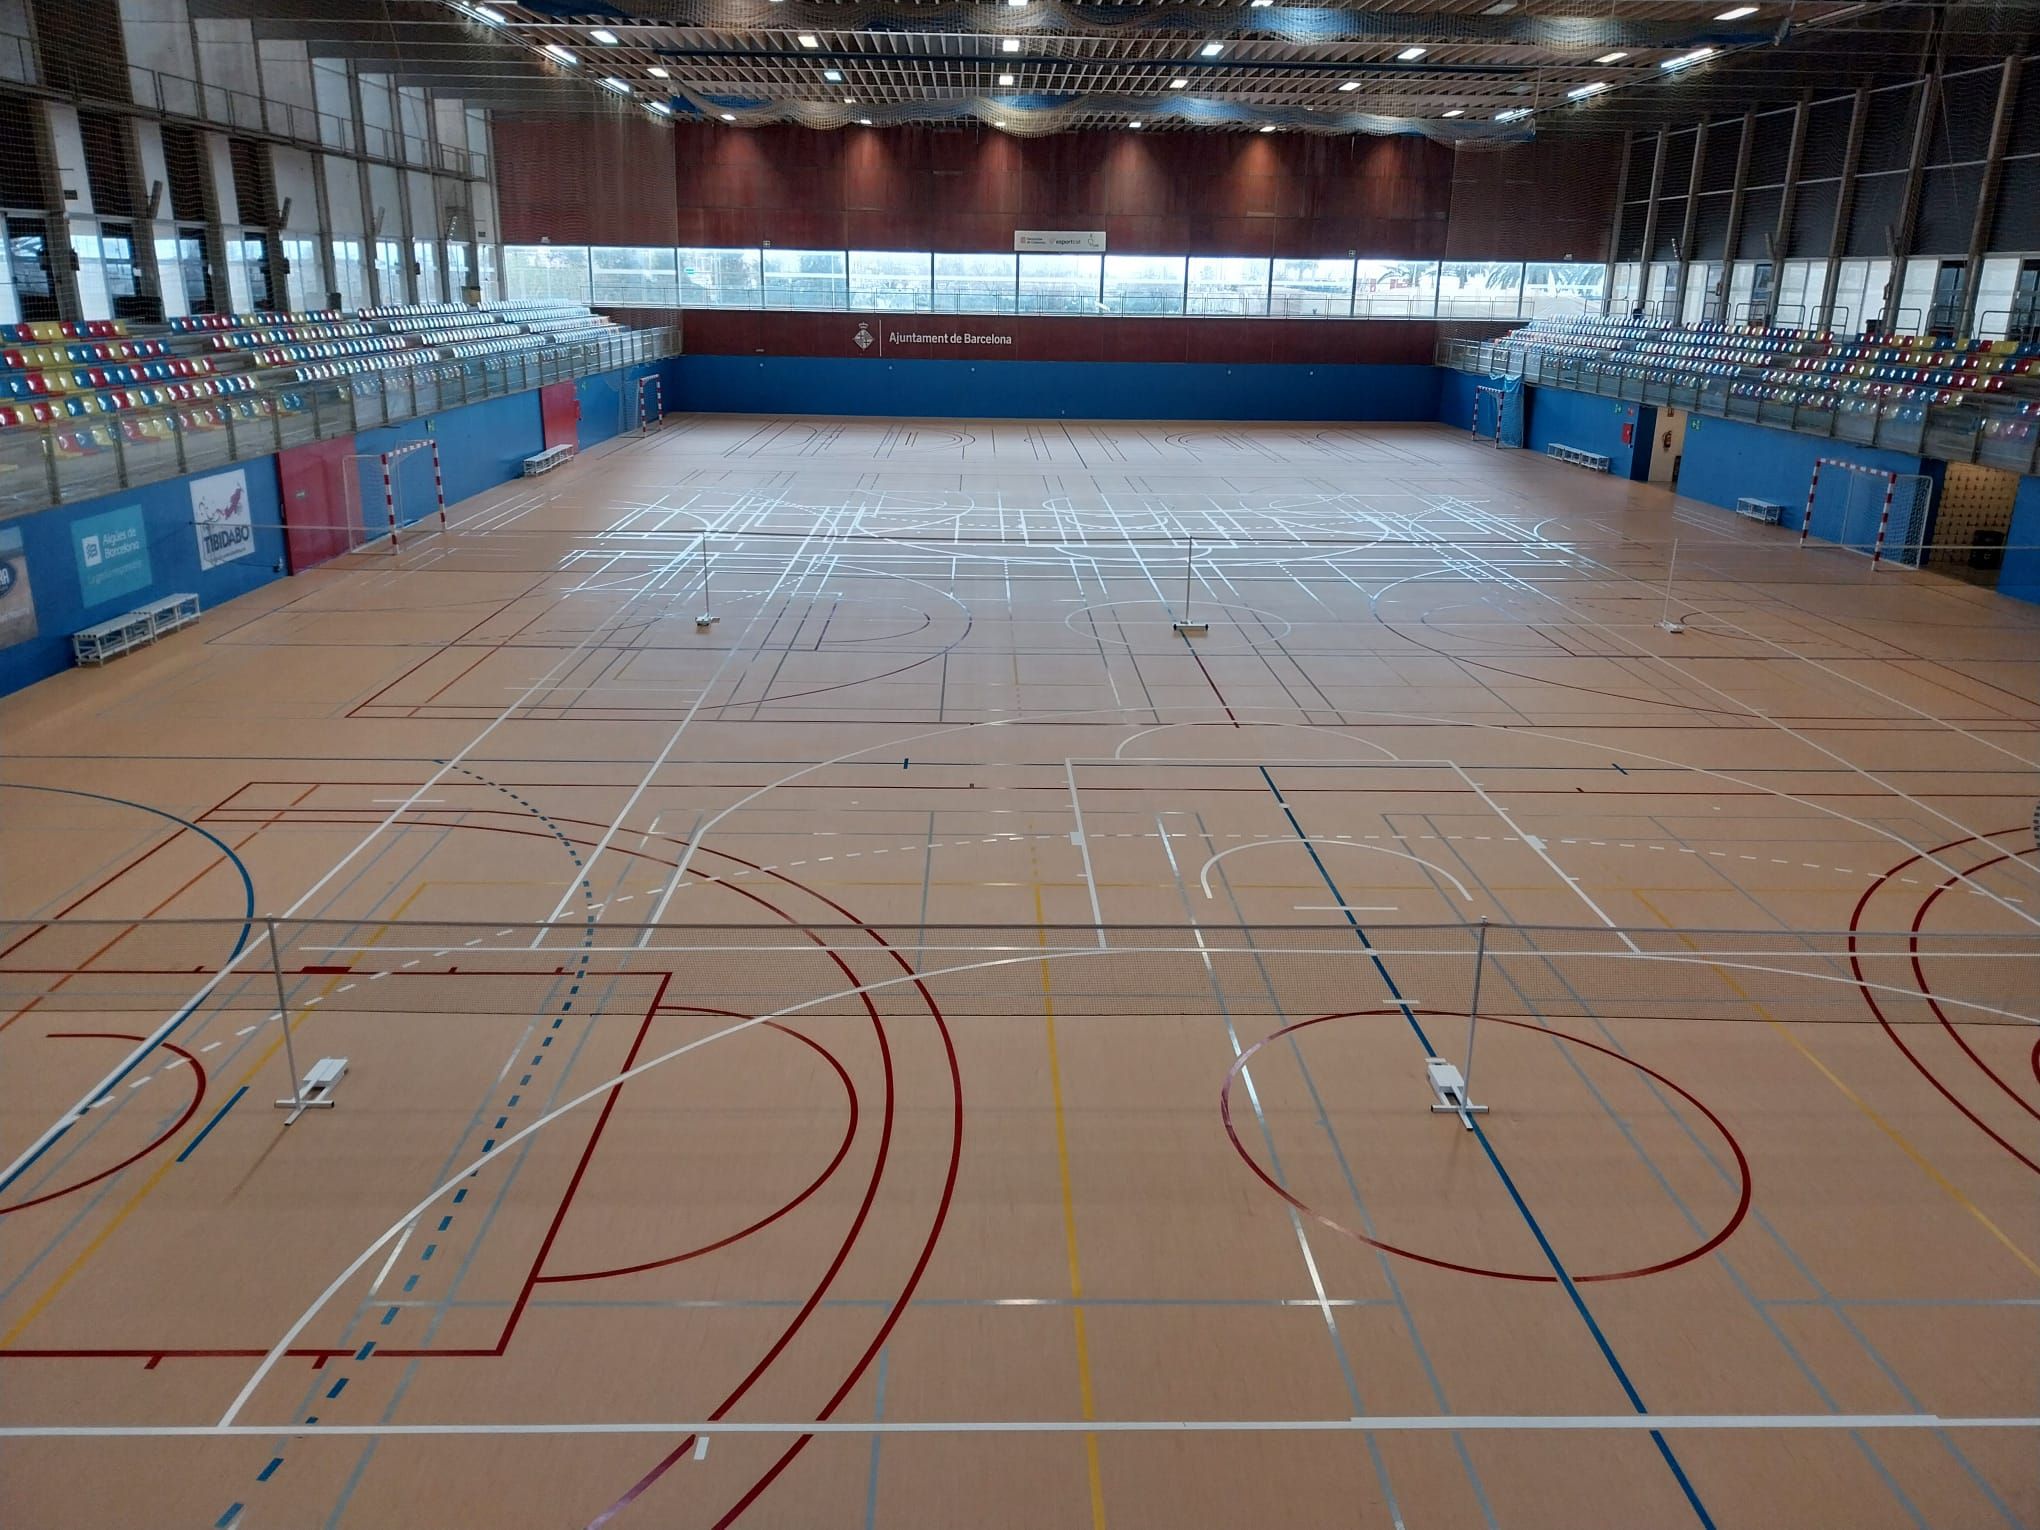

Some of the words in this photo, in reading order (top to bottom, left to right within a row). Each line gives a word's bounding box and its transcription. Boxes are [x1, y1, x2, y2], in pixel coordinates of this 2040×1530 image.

[889, 332, 949, 345] Ajuntament
[950, 333, 962, 345] de
[964, 333, 1012, 345] Barcelona
[203, 526, 250, 554] TIBIDABO
